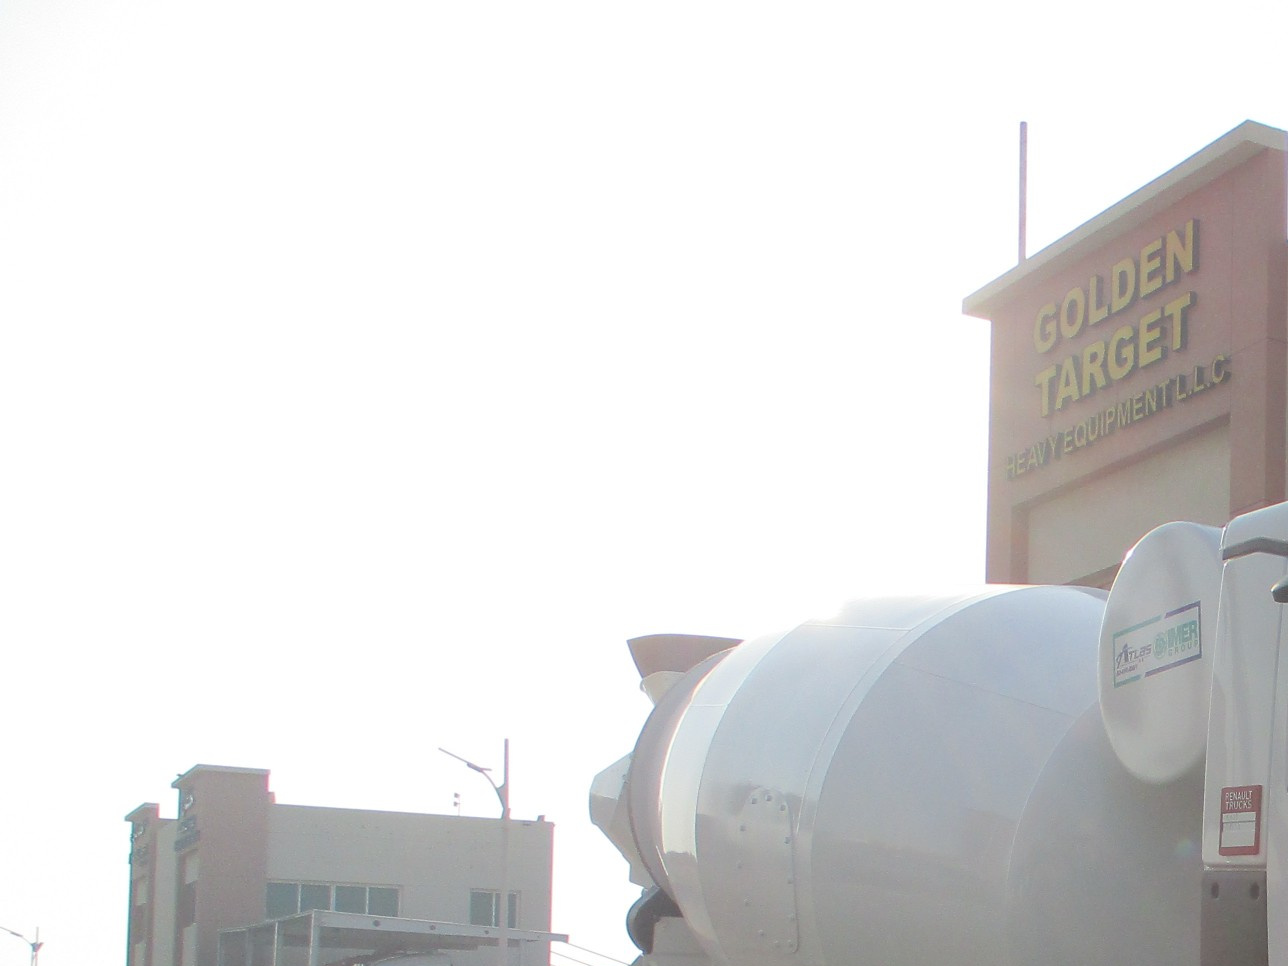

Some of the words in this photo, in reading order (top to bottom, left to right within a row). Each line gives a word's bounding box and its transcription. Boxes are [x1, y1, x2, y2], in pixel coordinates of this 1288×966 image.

[1033, 218, 1198, 354] GOLDEN
[1034, 290, 1195, 418] TARGET
[1005, 431, 1062, 480] HEAVY
[1063, 377, 1171, 455] EQUIPMENT
[1175, 354, 1232, 401] L.L.C
[1168, 640, 1199, 657] GROUP
[1225, 790, 1253, 801] RENAULT
[1225, 800, 1252, 811] TRUCKS
